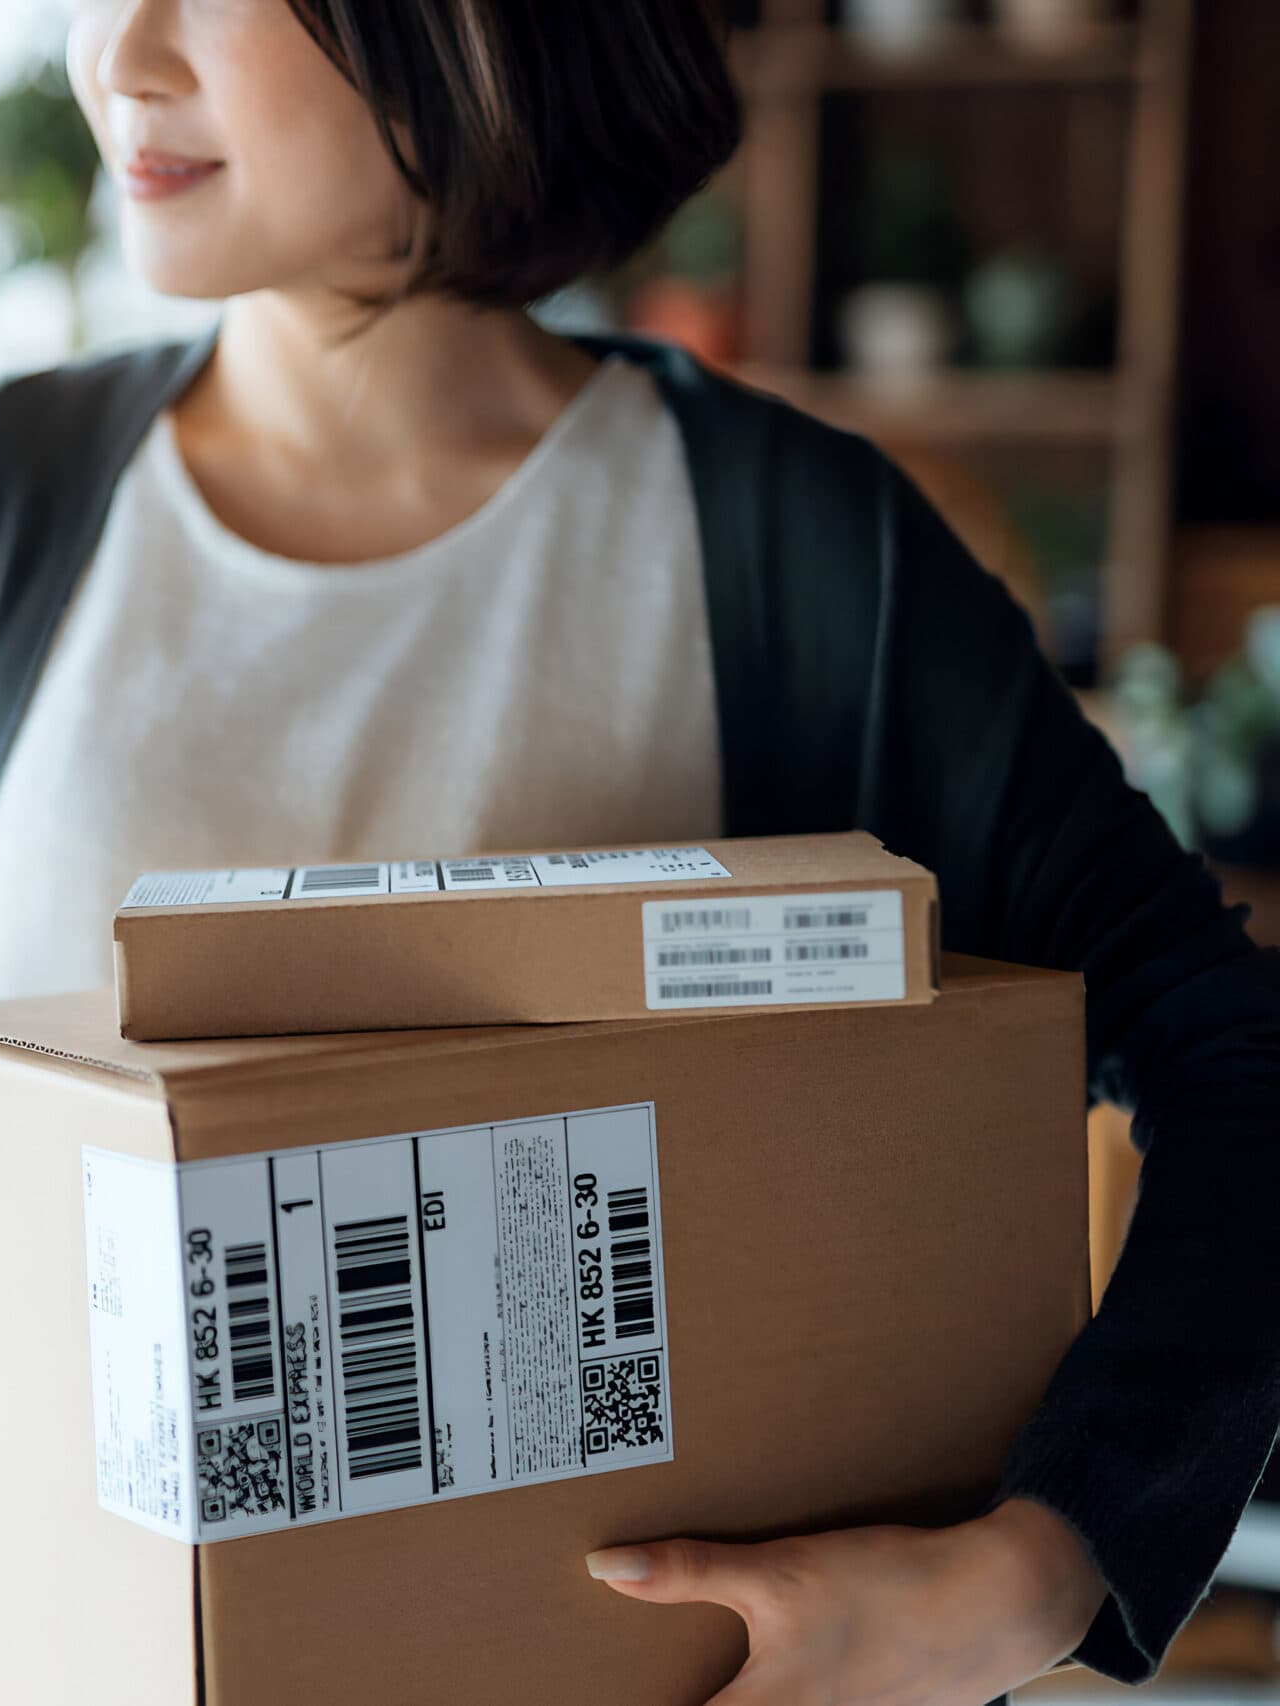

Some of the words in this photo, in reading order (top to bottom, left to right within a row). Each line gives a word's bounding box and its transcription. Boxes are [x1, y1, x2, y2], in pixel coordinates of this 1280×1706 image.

[280, 1199, 314, 1214] 1
[422, 1191, 446, 1232] EDI
[573, 1172, 600, 1240] 6-30
[187, 1228, 216, 1298] 6-30
[578, 1247, 604, 1301] 852
[192, 1306, 218, 1361] 852
[581, 1307, 606, 1349] HK
[195, 1368, 222, 1411] HK
[286, 1321, 312, 1425] EXPRESS
[293, 1432, 317, 1515] WORLD
